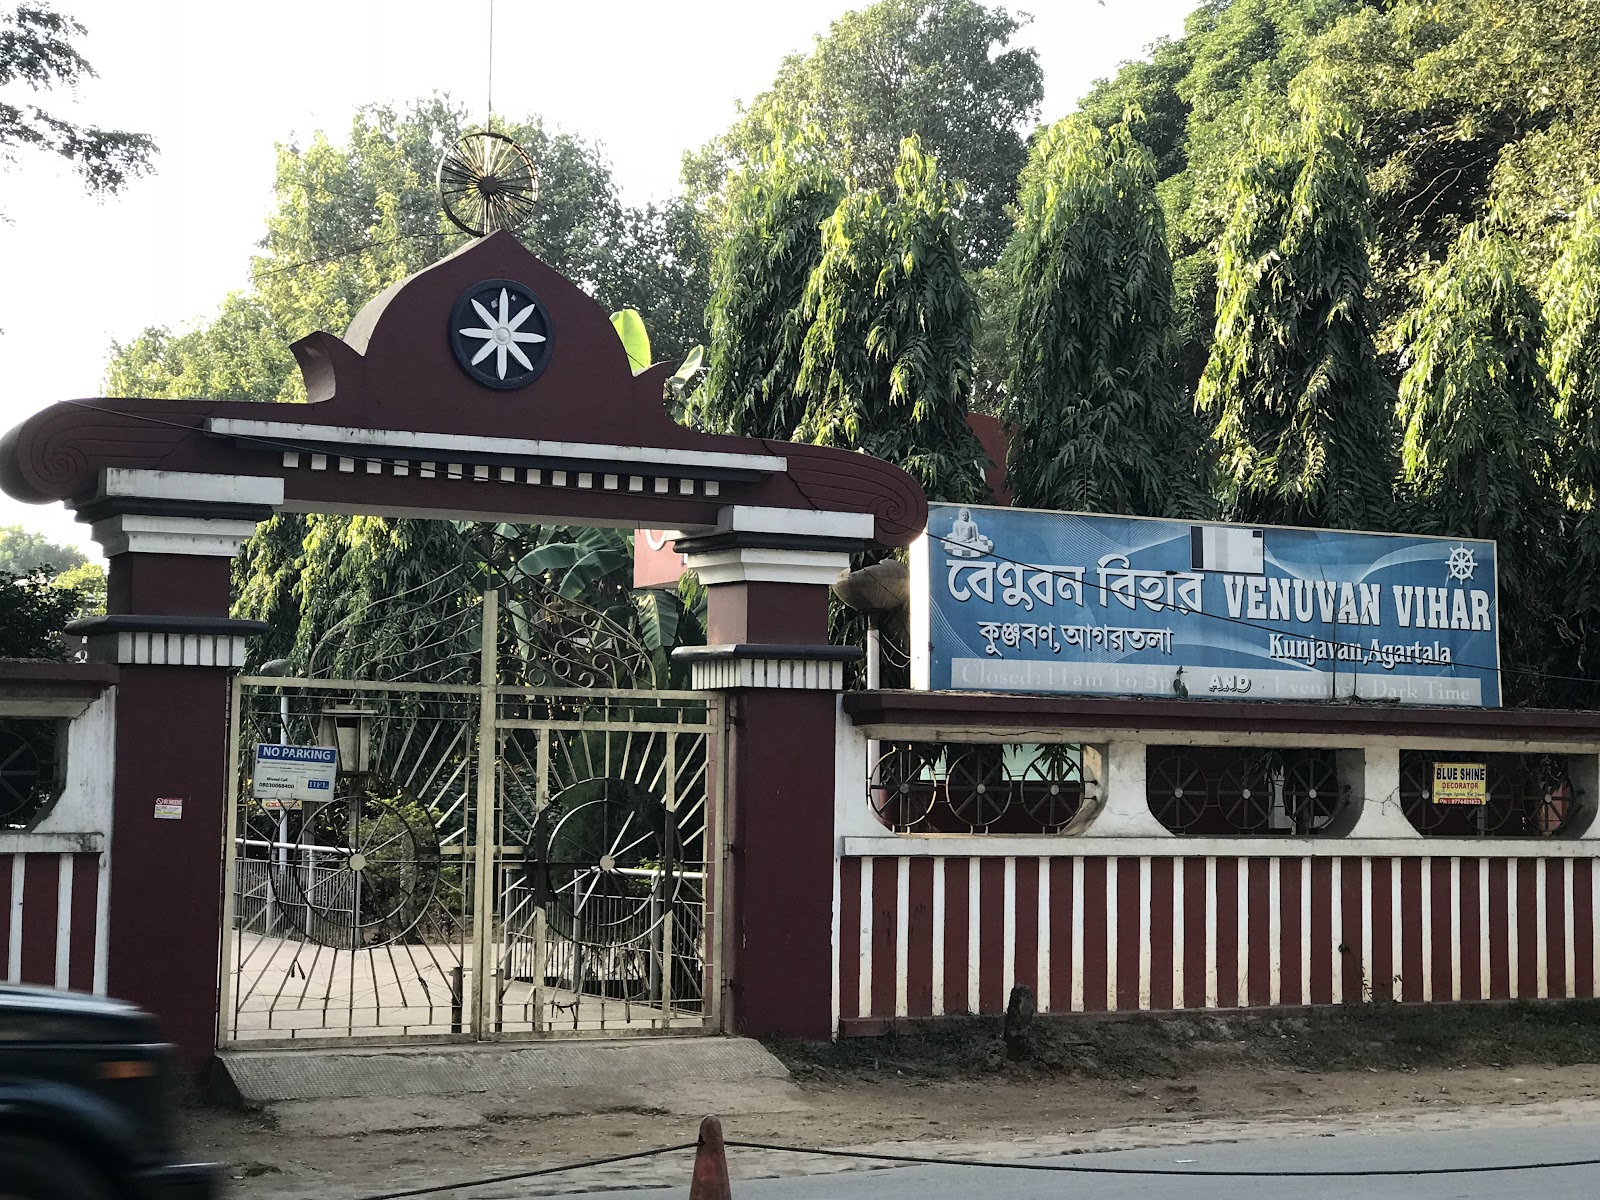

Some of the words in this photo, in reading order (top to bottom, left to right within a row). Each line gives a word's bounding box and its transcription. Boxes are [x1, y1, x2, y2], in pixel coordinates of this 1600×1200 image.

[946, 559, 1085, 612] বেণুবন
[1097, 553, 1205, 615] বিহার
[1223, 575, 1381, 626] VENUVAN
[1392, 585, 1492, 631] VIHAR
[1110, 668, 1138, 689] To
[1145, 671, 1188, 694] 3p
[1209, 673, 1251, 692] AND
[1373, 677, 1418, 698] Dark
[1424, 680, 1470, 701] Time
[263, 747, 280, 757] NO
[282, 748, 331, 760] PARKING
[1436, 768, 1458, 780] BLUE
[1460, 768, 1485, 780] SHINE
